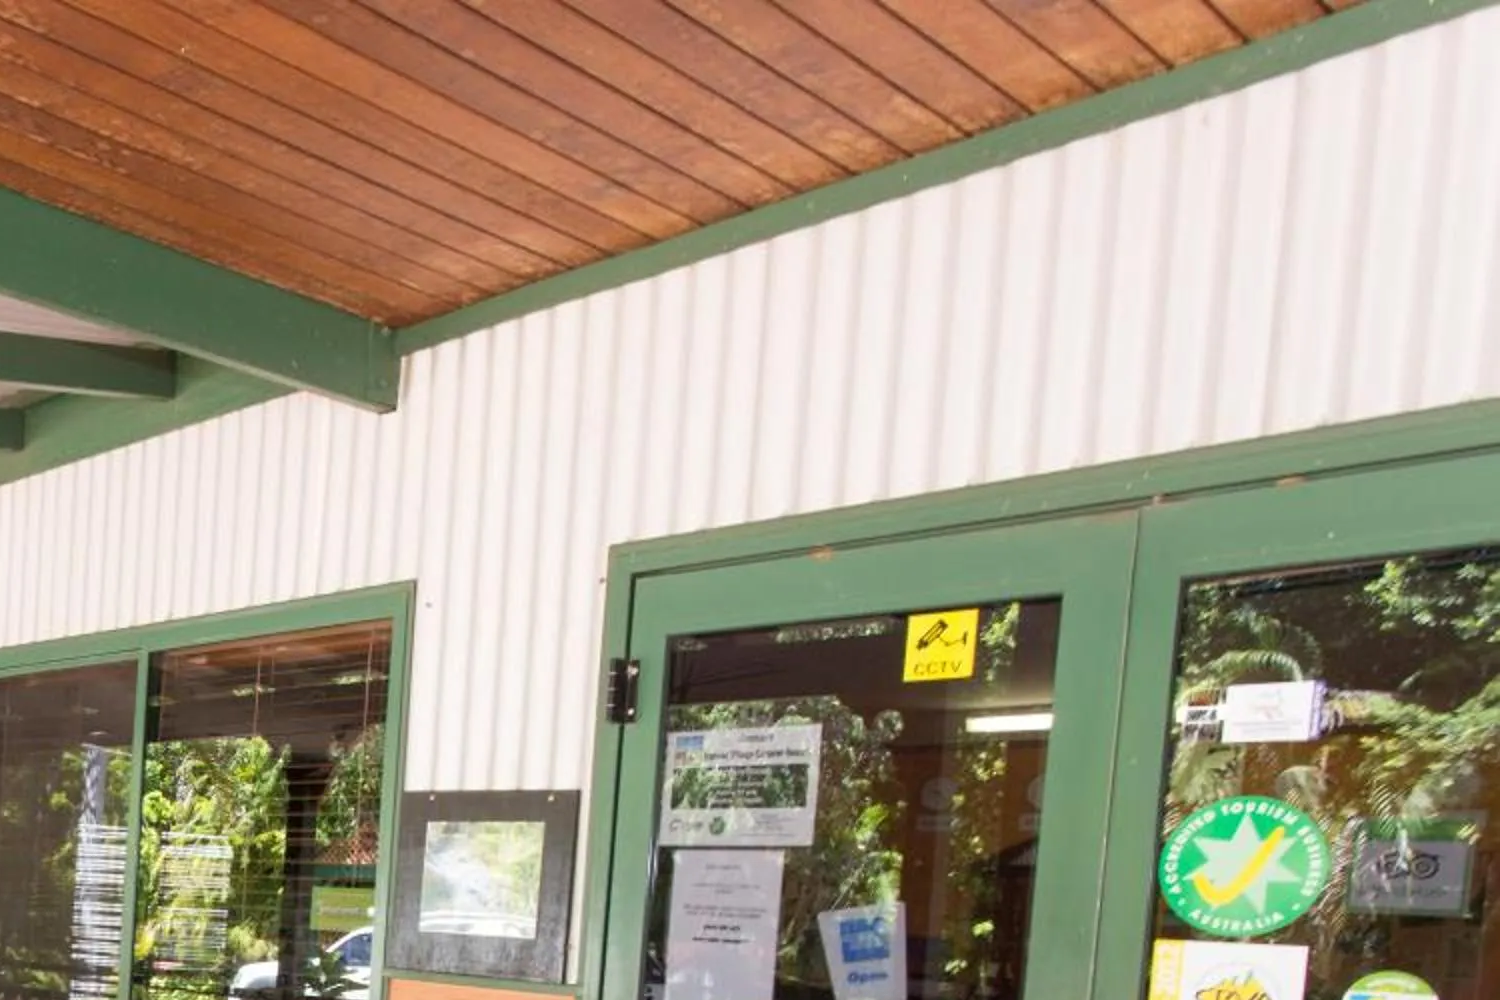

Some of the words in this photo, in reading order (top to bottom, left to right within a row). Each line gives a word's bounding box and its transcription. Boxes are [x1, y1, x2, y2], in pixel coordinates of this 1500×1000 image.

[912, 659, 964, 677] CCTV
[1221, 800, 1299, 825] TOURISM
[1188, 908, 1285, 931] AUSTRALIA
